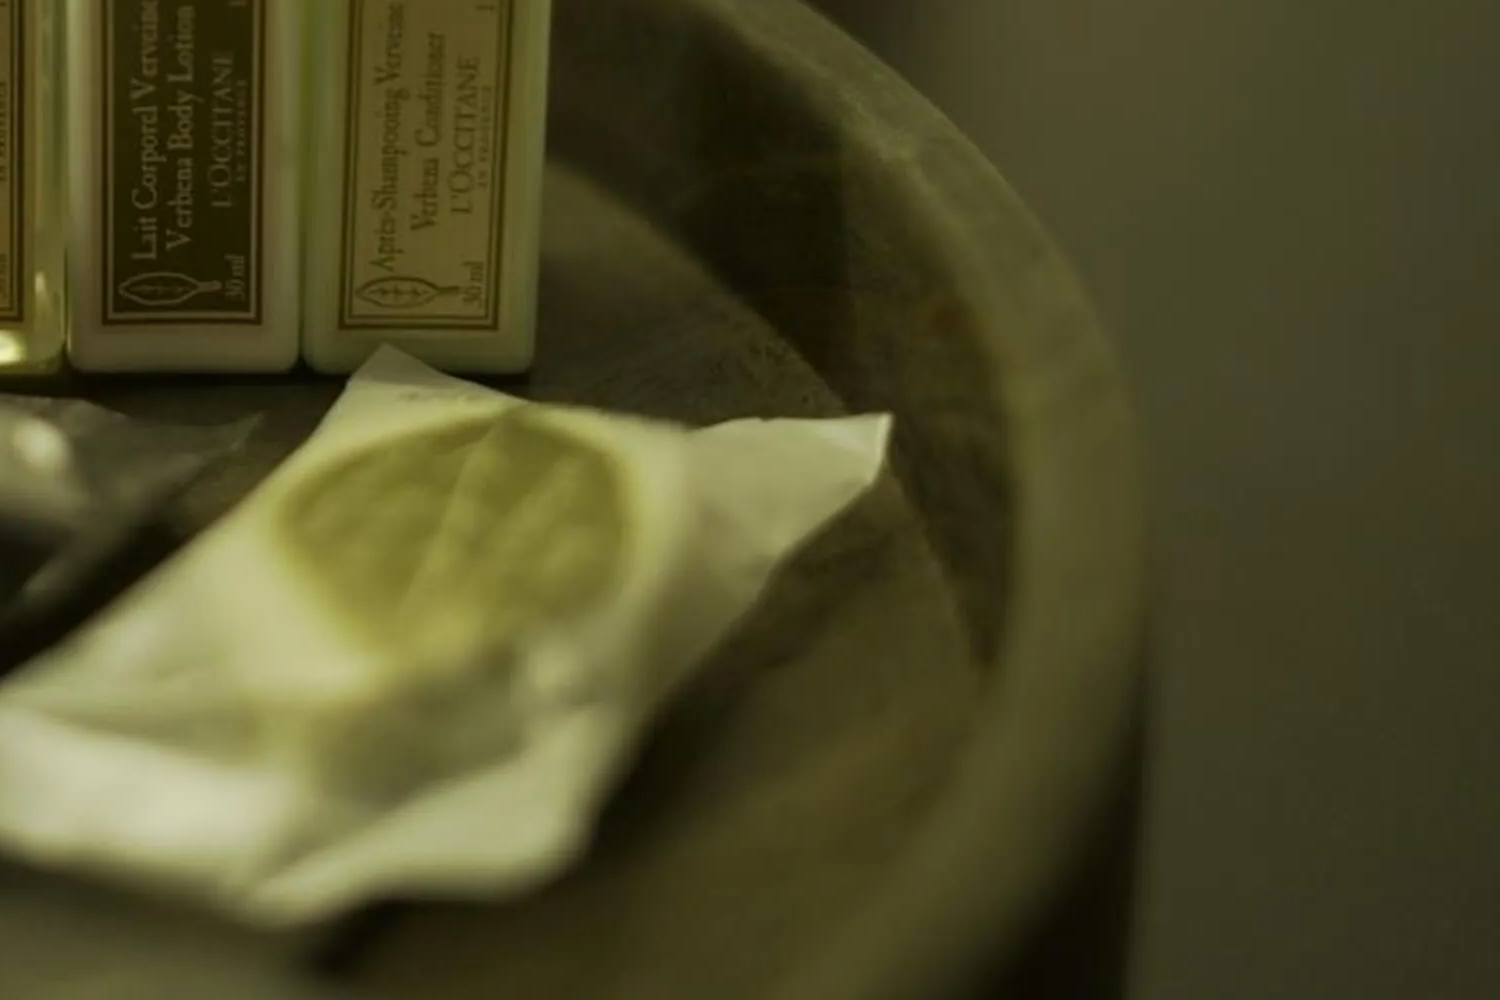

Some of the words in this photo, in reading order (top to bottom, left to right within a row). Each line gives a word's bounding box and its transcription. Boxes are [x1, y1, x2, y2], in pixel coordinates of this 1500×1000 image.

[168, 5, 194, 82] Lotion
[376, 2, 405, 82] Verveine
[168, 90, 203, 150] Body
[415, 32, 444, 147] Conditioner
[131, 106, 165, 209] Corporel
[166, 158, 193, 250] Verbena
[412, 158, 440, 230] Verbena
[131, 216, 157, 260] Lait
[224, 254, 245, 276] ml
[226, 278, 245, 301] 30
[462, 260, 485, 283] ml
[463, 285, 483, 308] 30
